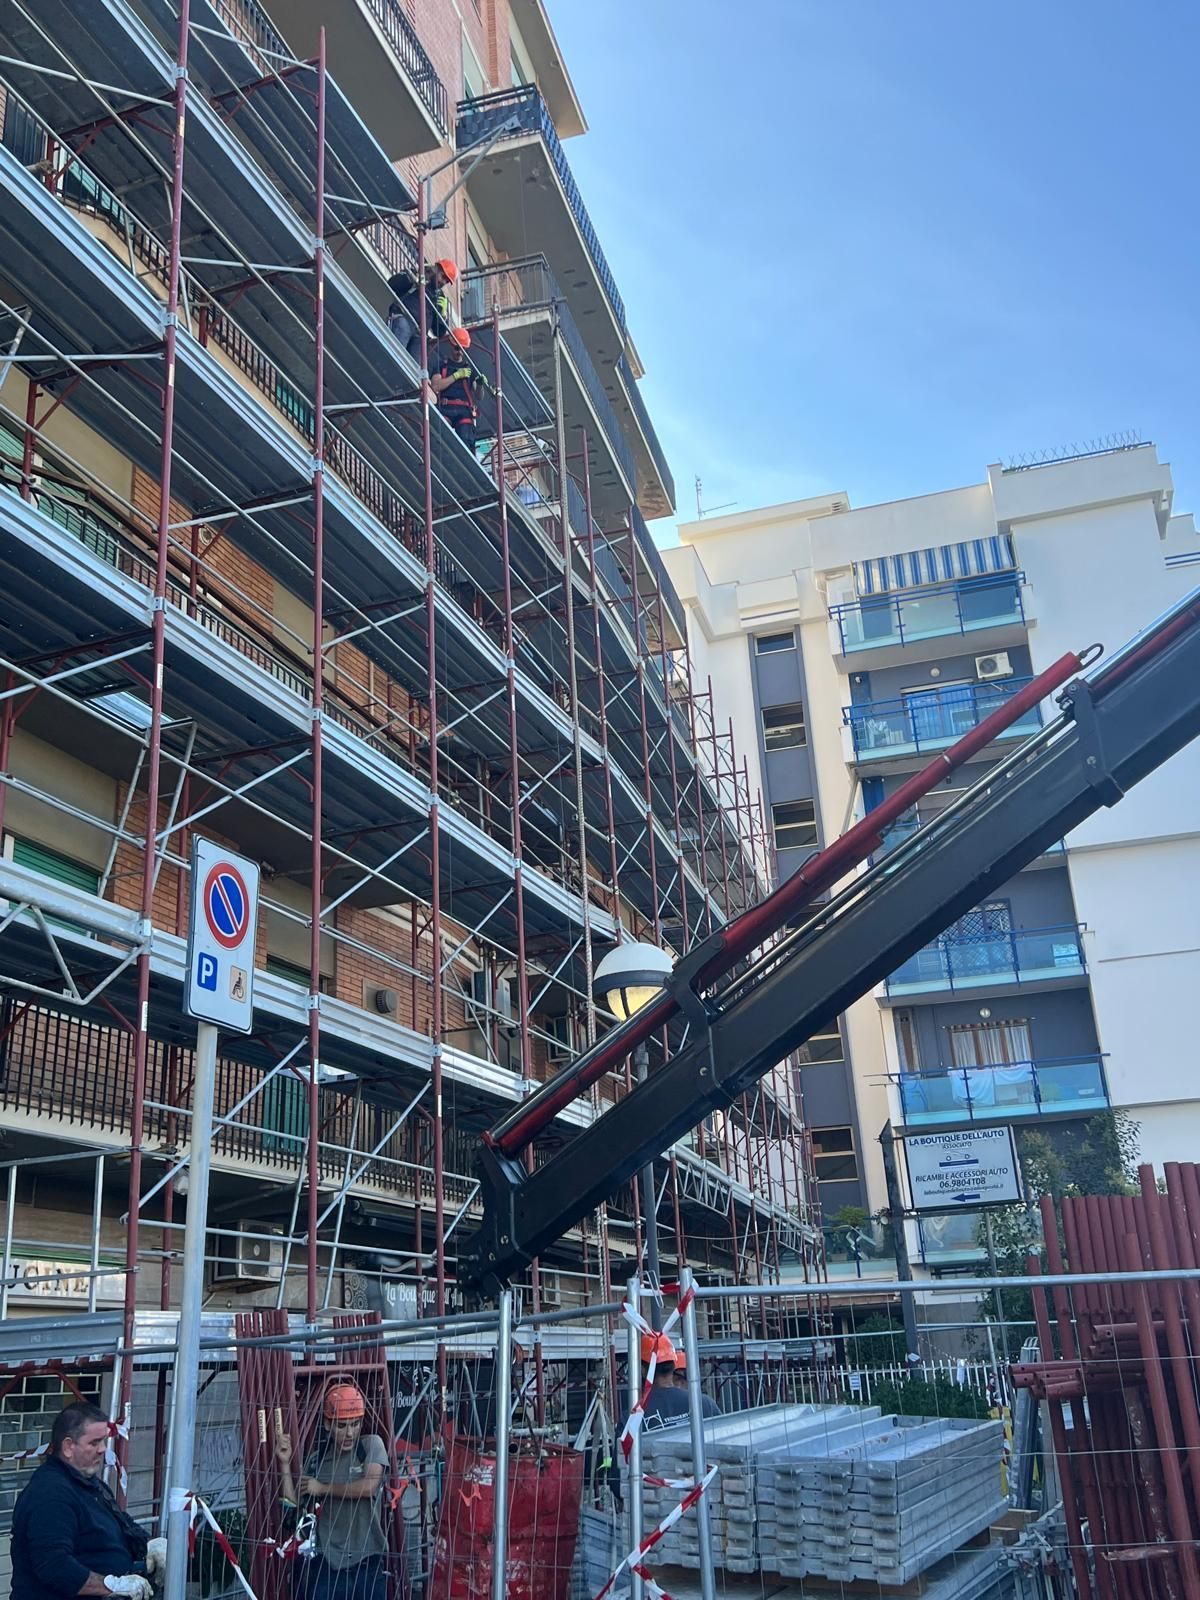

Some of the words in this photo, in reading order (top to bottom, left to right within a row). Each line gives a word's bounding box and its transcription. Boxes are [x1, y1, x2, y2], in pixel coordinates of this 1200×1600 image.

[201, 957, 213, 984] P
[909, 1138, 919, 1146] LA
[920, 1134, 961, 1145] BOUTIQUE
[962, 1130, 1004, 1140] DELL'AUTO
[916, 1173, 944, 1182] RICAMBI
[950, 1169, 988, 1179] ACCESSORI
[988, 1167, 1009, 1176] AUTO
[939, 1176, 986, 1188] 06.9804108
[385, 1281, 396, 1307] La
[398, 1282, 436, 1309] Bouque
